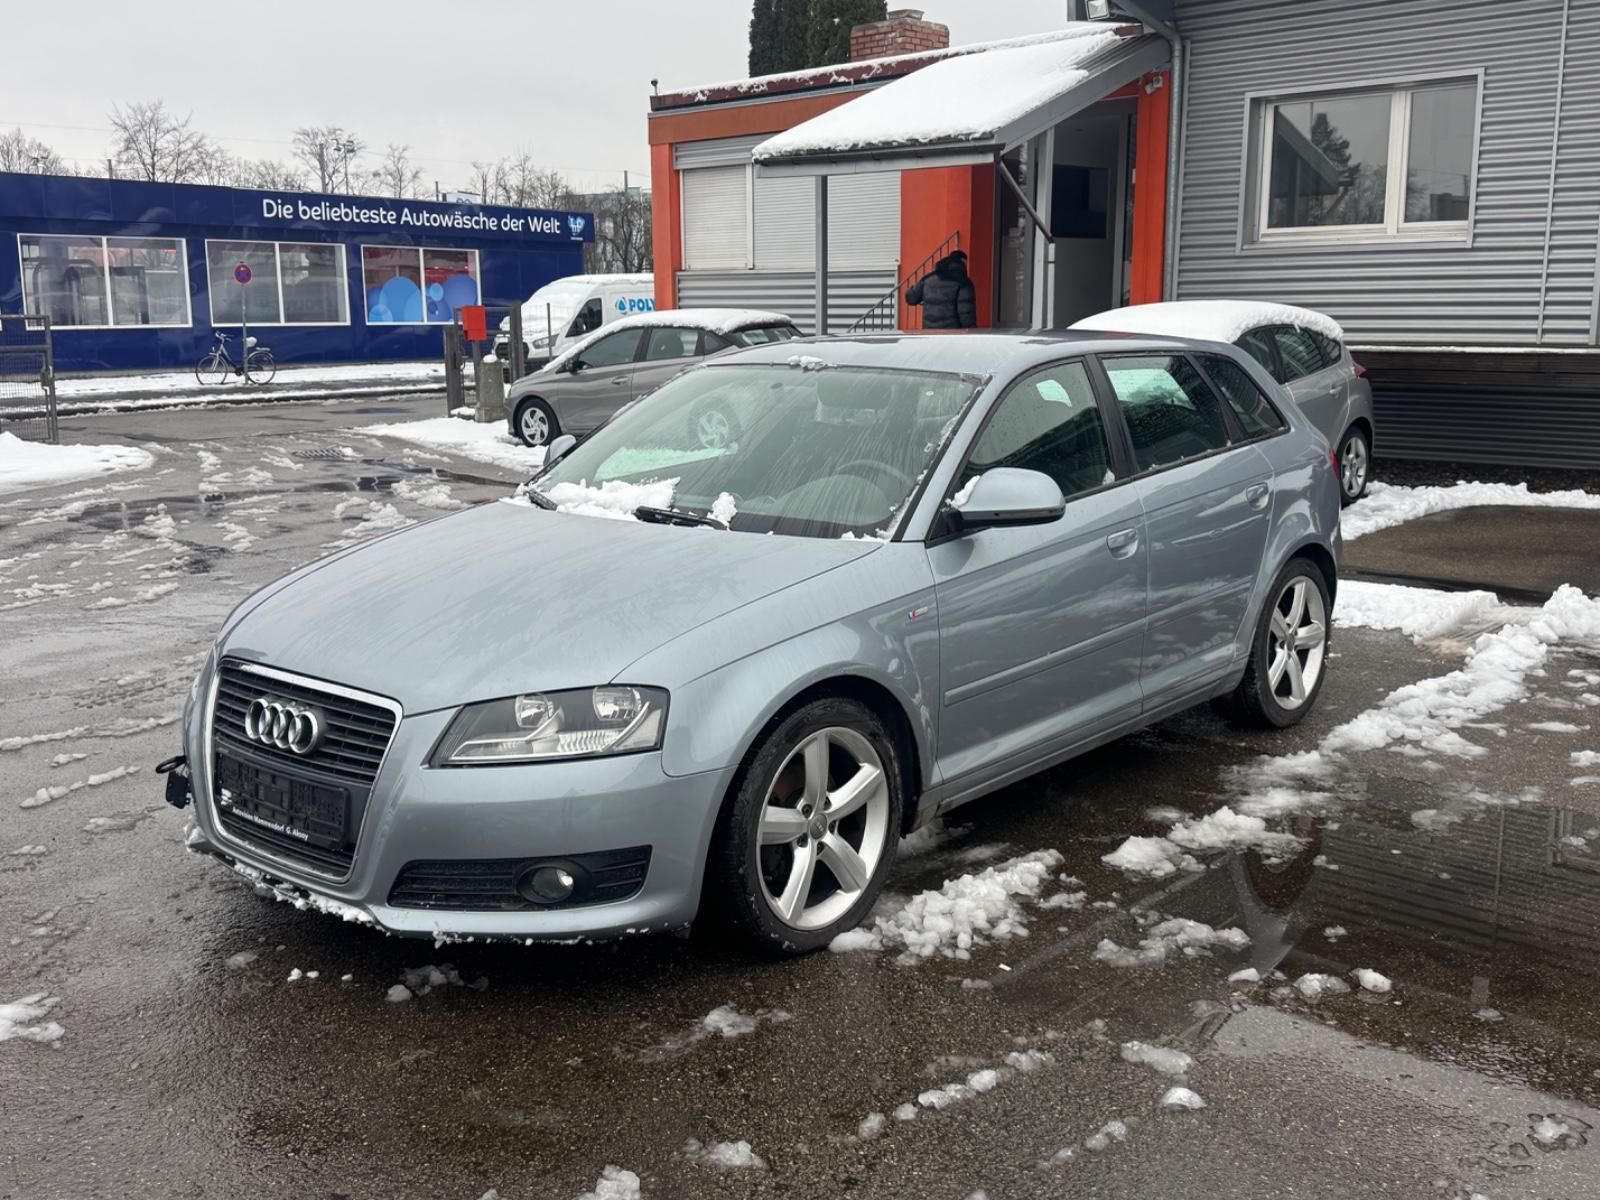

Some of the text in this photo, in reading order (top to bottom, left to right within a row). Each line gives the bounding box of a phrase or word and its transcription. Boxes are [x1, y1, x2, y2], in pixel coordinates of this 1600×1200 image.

[262, 199, 560, 234] Die beliebteste Autowäsche der Welt
